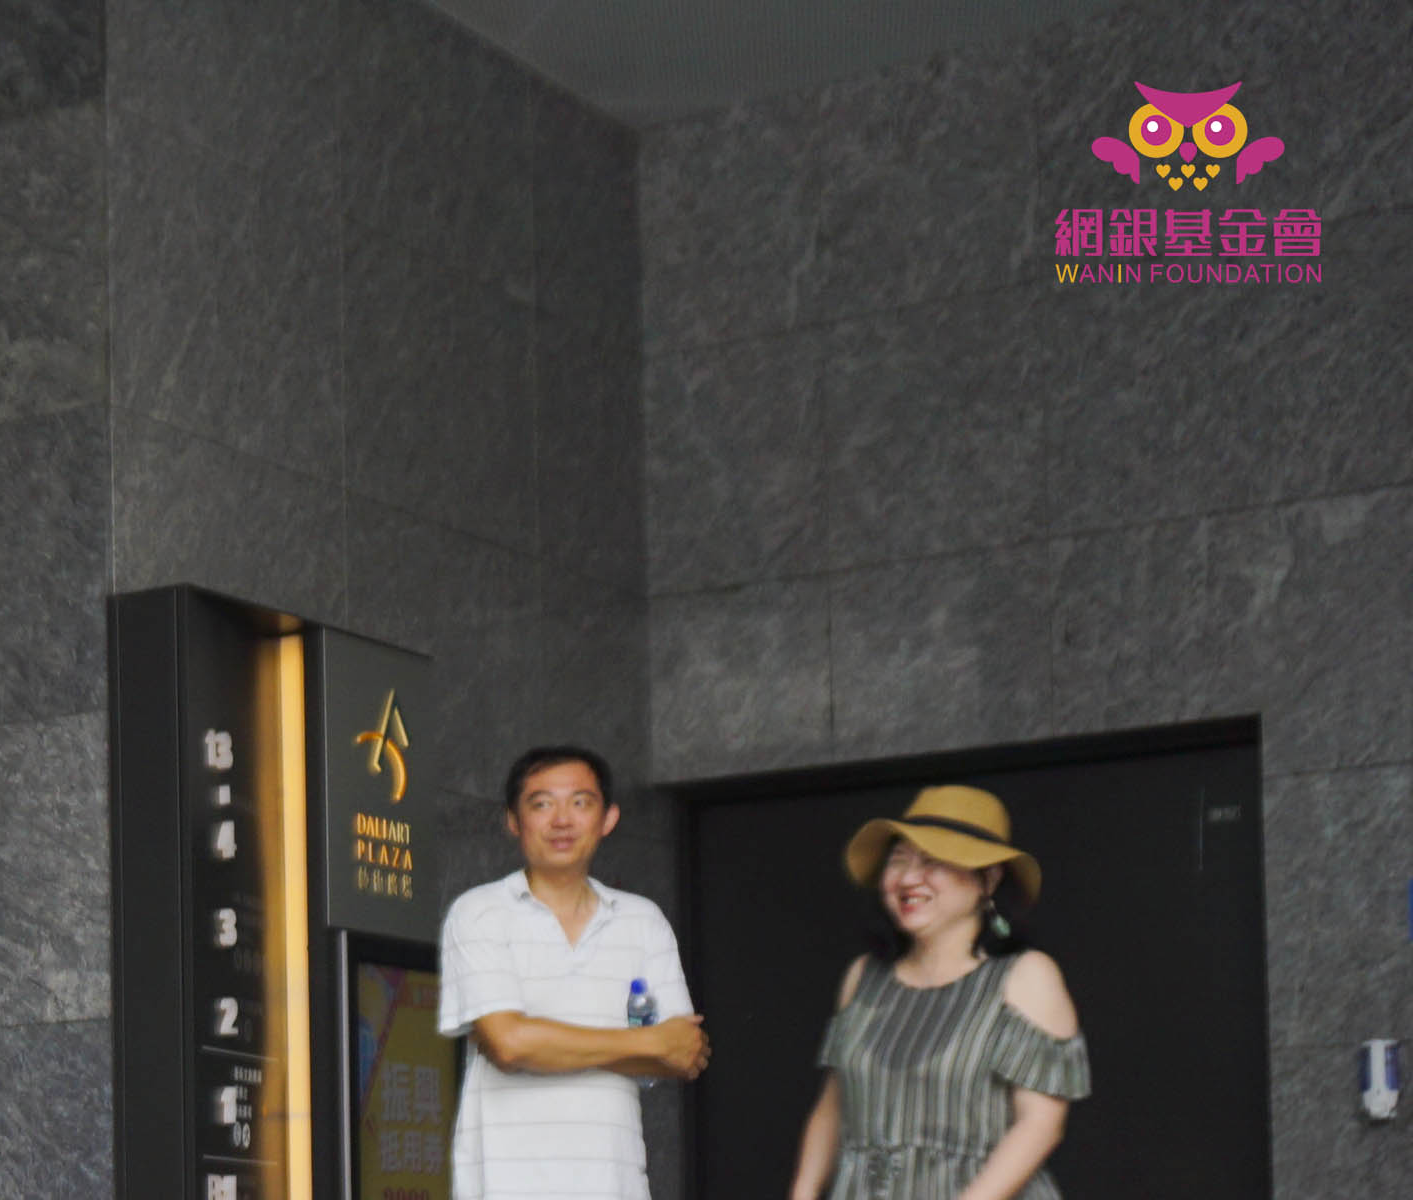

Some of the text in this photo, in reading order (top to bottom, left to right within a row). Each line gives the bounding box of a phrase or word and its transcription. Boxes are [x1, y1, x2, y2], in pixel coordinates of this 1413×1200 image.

[205, 728, 234, 770] 13
[216, 820, 237, 860] 4
[357, 839, 413, 871] PLAZA
[213, 907, 238, 947] 3
[213, 997, 239, 1036] 2
[220, 1085, 237, 1125] 1
